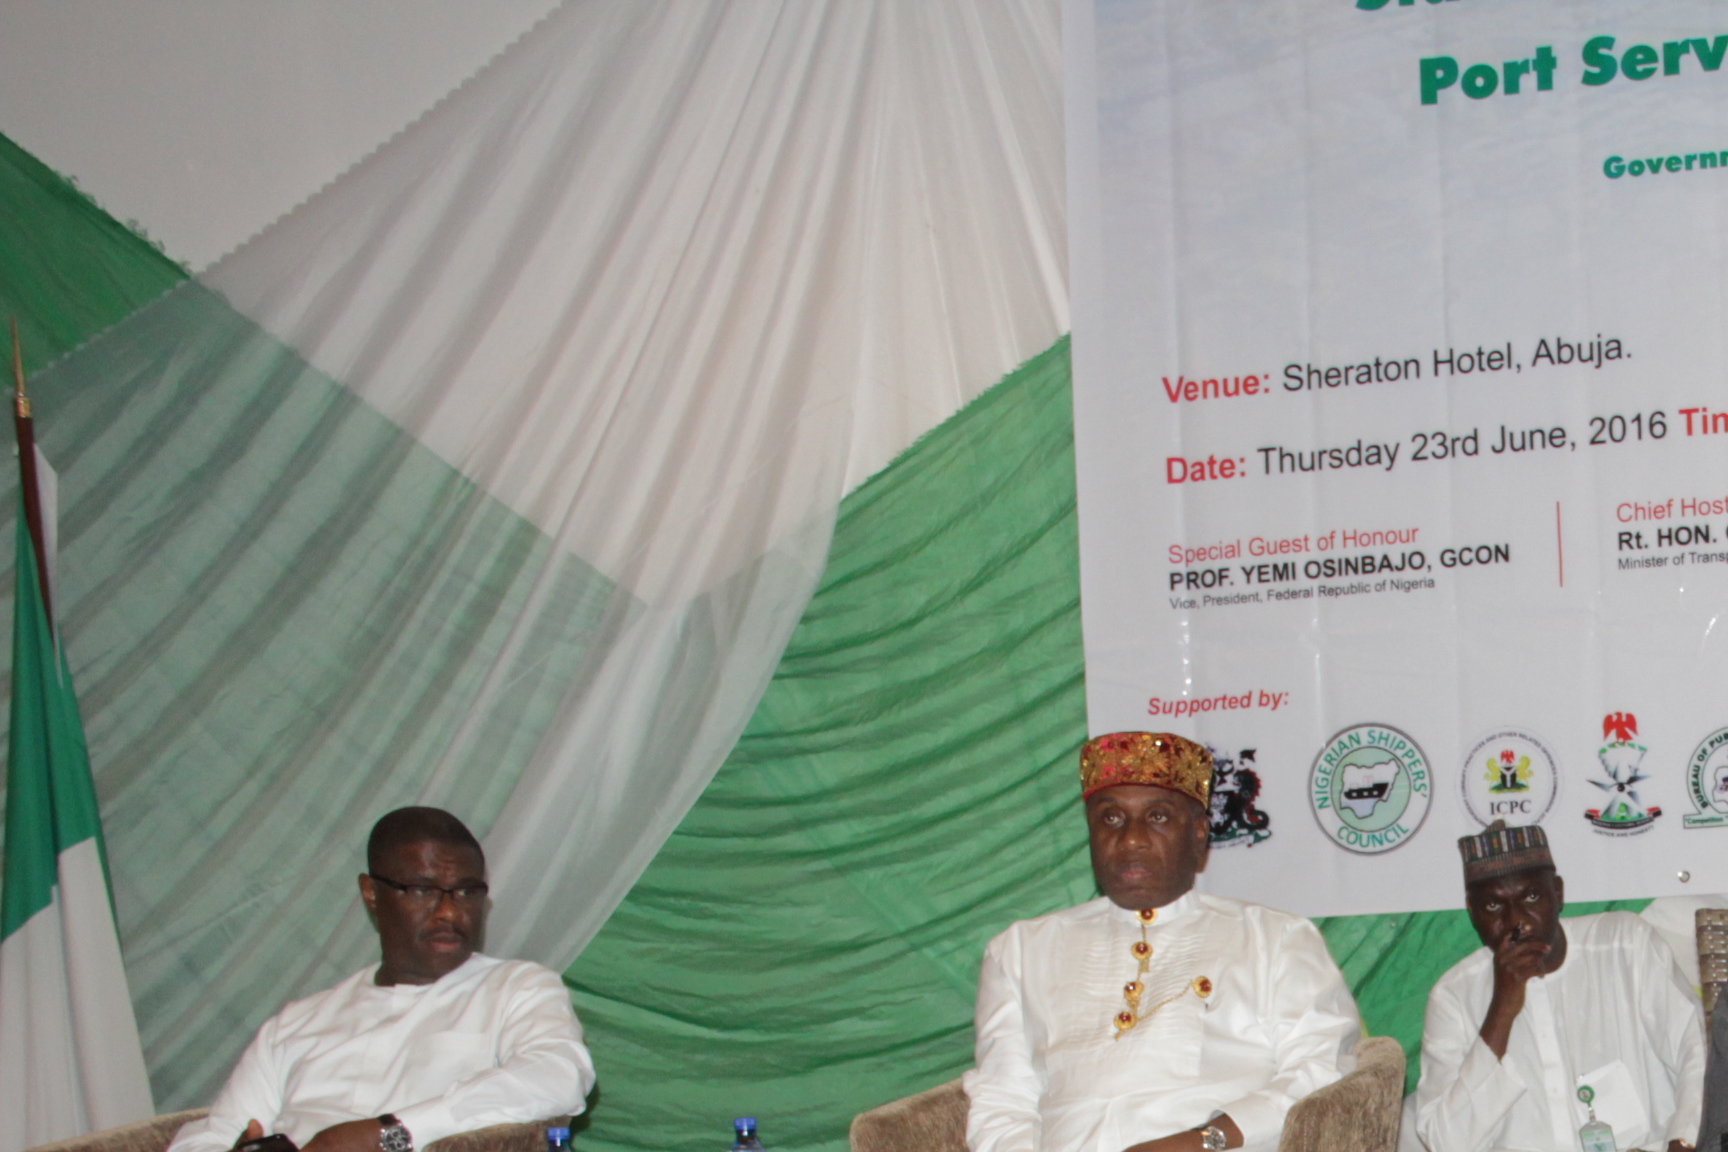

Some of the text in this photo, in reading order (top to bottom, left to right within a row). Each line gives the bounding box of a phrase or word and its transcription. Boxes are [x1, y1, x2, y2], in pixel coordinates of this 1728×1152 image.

[1420, 46, 1557, 105] Port
[1162, 332, 1632, 403] Venue: Sheraton Hotel, Abuja.
[1165, 454, 1247, 485] Date:
[1257, 437, 1401, 477] Thursday
[1411, 425, 1480, 462] 23rd
[1491, 421, 1577, 457] June,
[1589, 410, 1668, 447] 2016
[1616, 498, 1674, 522] Chief
[1168, 526, 1420, 567] Special Guest of Honour
[1617, 530, 1650, 551] Rt.
[1657, 525, 1718, 549] HON.
[1169, 543, 1510, 591] PROF. YEMI OSINBAJO, GCON
[1617, 554, 1669, 571] Minister
[1672, 553, 1685, 566] of
[1267, 585, 1314, 602] Federal
[1318, 580, 1374, 600] Republic
[1374, 579, 1387, 593] of
[1390, 576, 1435, 594] Nigeria
[1147, 689, 1289, 719] Supported by:
[1314, 731, 1361, 810] NIGERIAN
[1691, 764, 1709, 810] BUREAU
[1489, 799, 1532, 816] ICPC
[1337, 823, 1410, 847] COUNCIL
